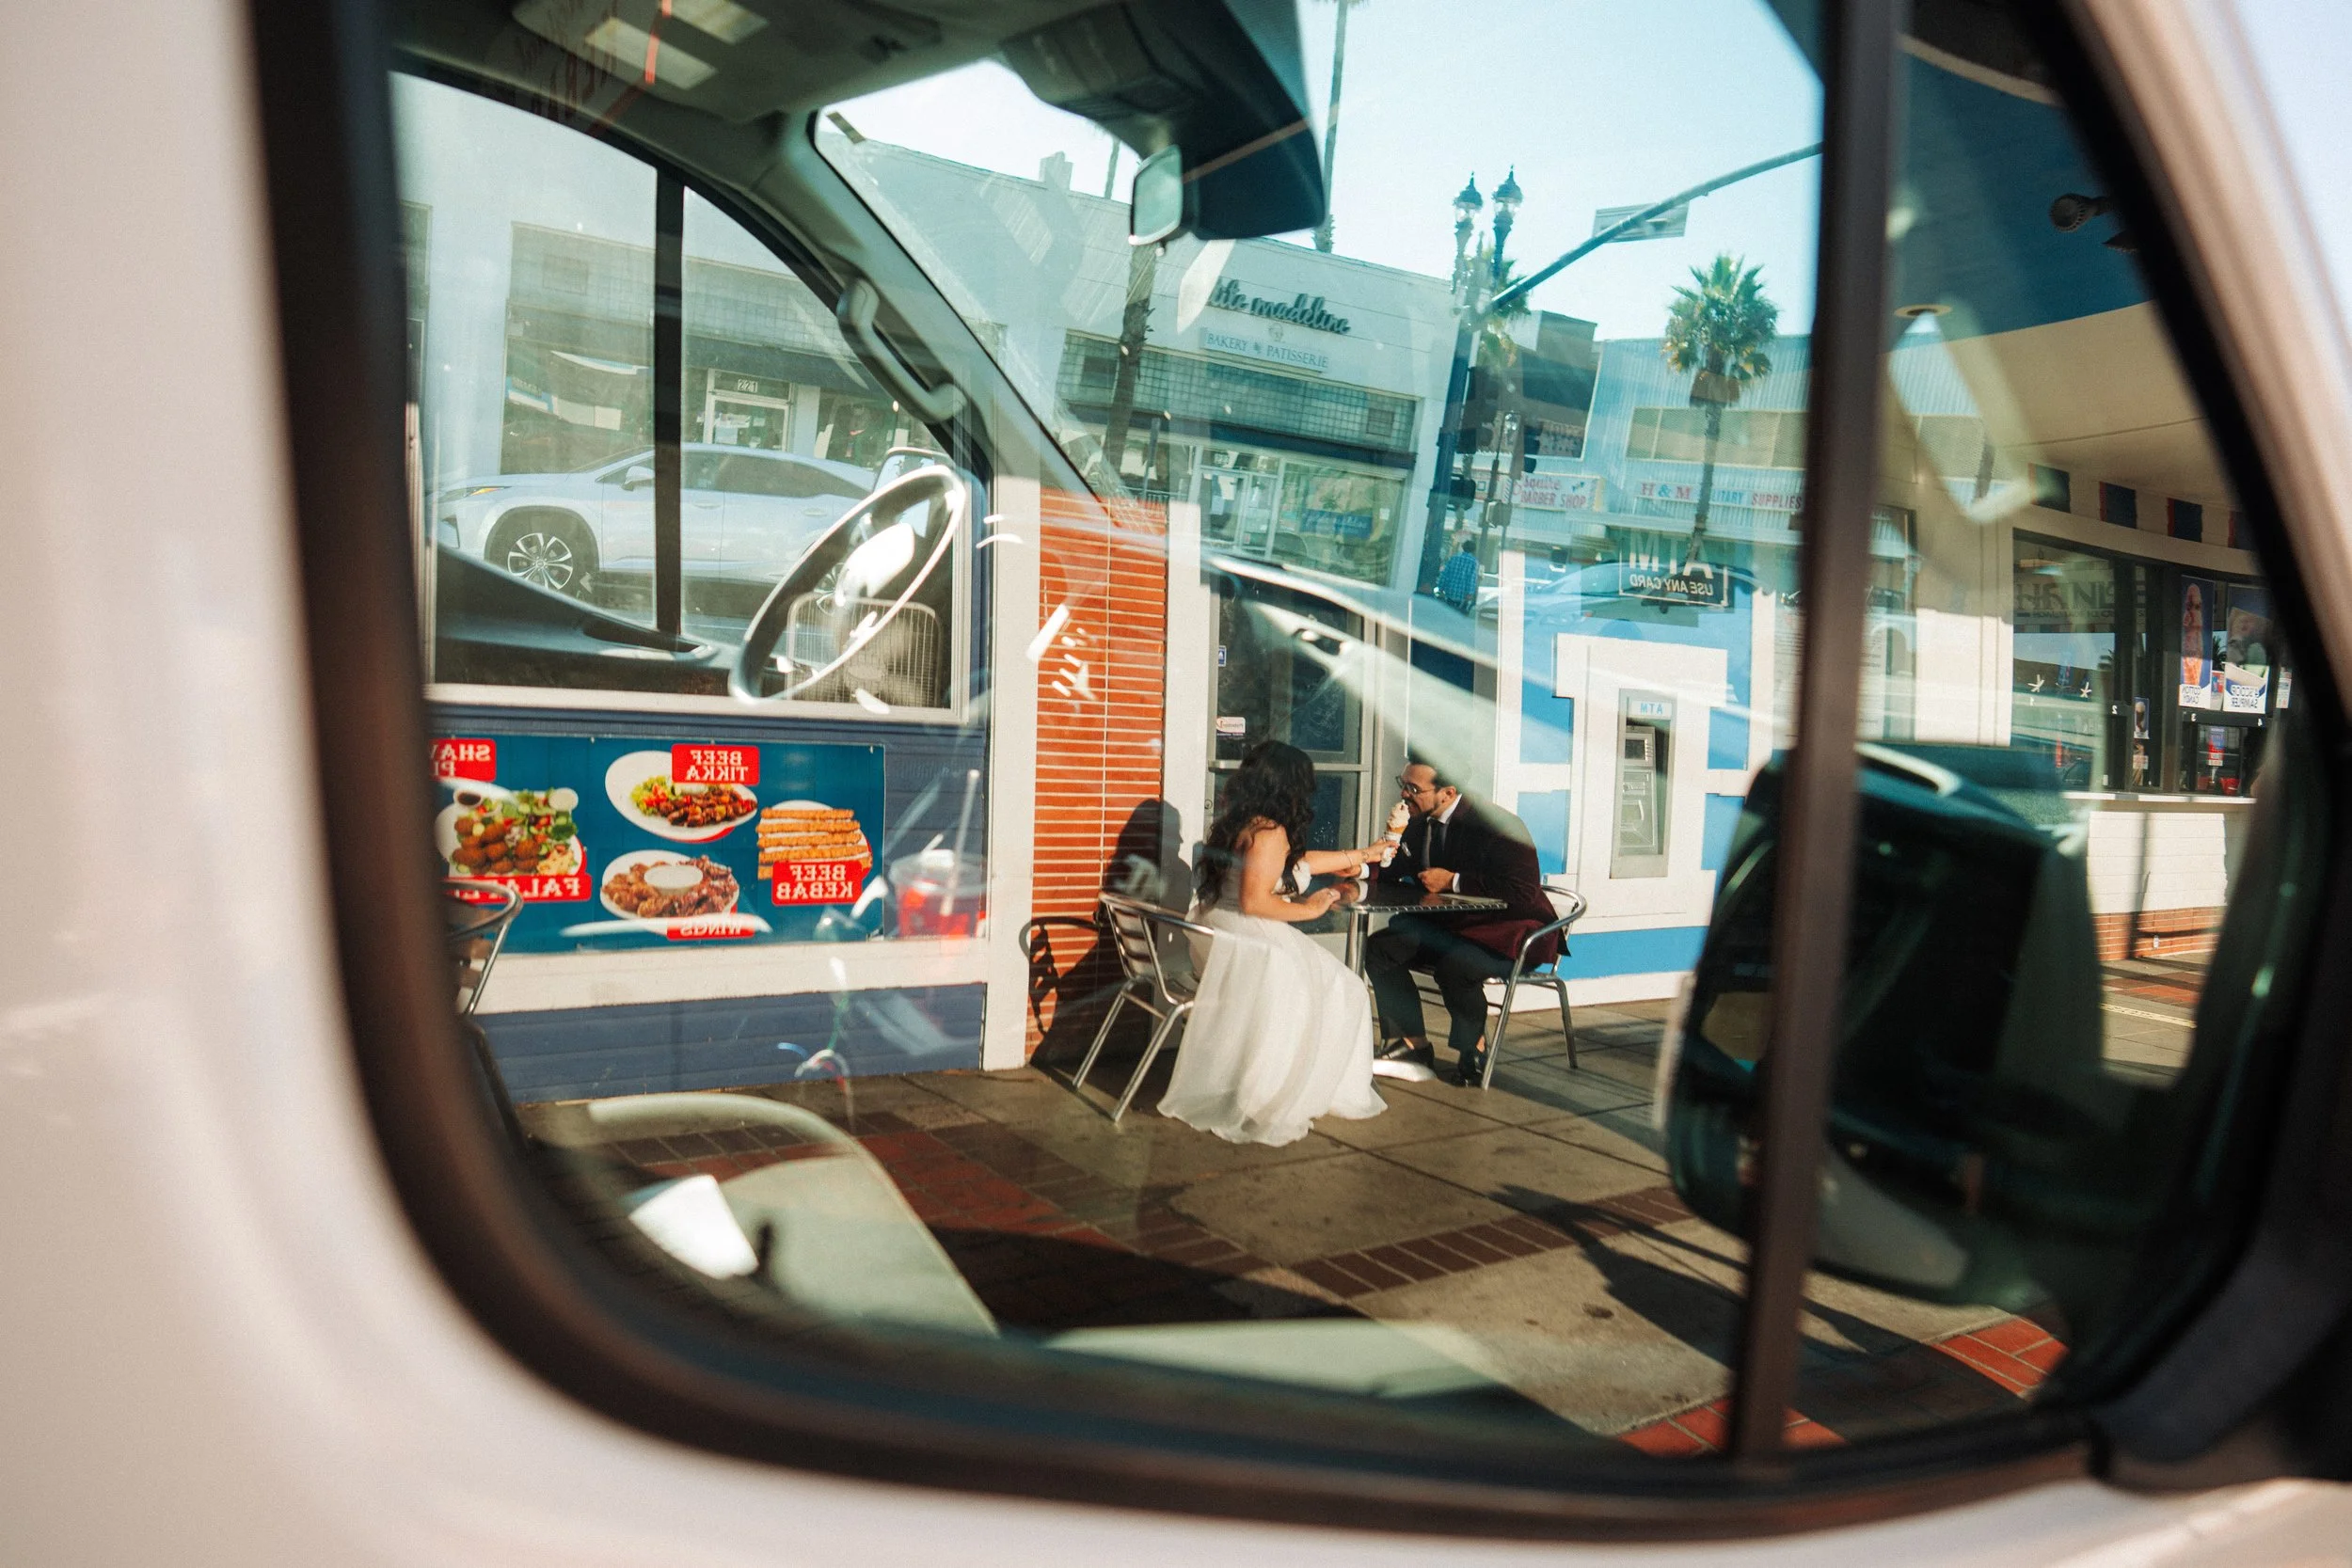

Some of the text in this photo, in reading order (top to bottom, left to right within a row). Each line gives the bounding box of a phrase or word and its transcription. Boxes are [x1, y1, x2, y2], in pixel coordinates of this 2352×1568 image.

[1250, 293, 1352, 335] madeline
[1206, 332, 1248, 352] BAKERY
[1266, 344, 1329, 369] PATISSERIE
[737, 378, 758, 393] 221
[1520, 491, 1586, 509] BARBER SHOP
[1641, 483, 1804, 510] H & M LITARY SUPPLIES
